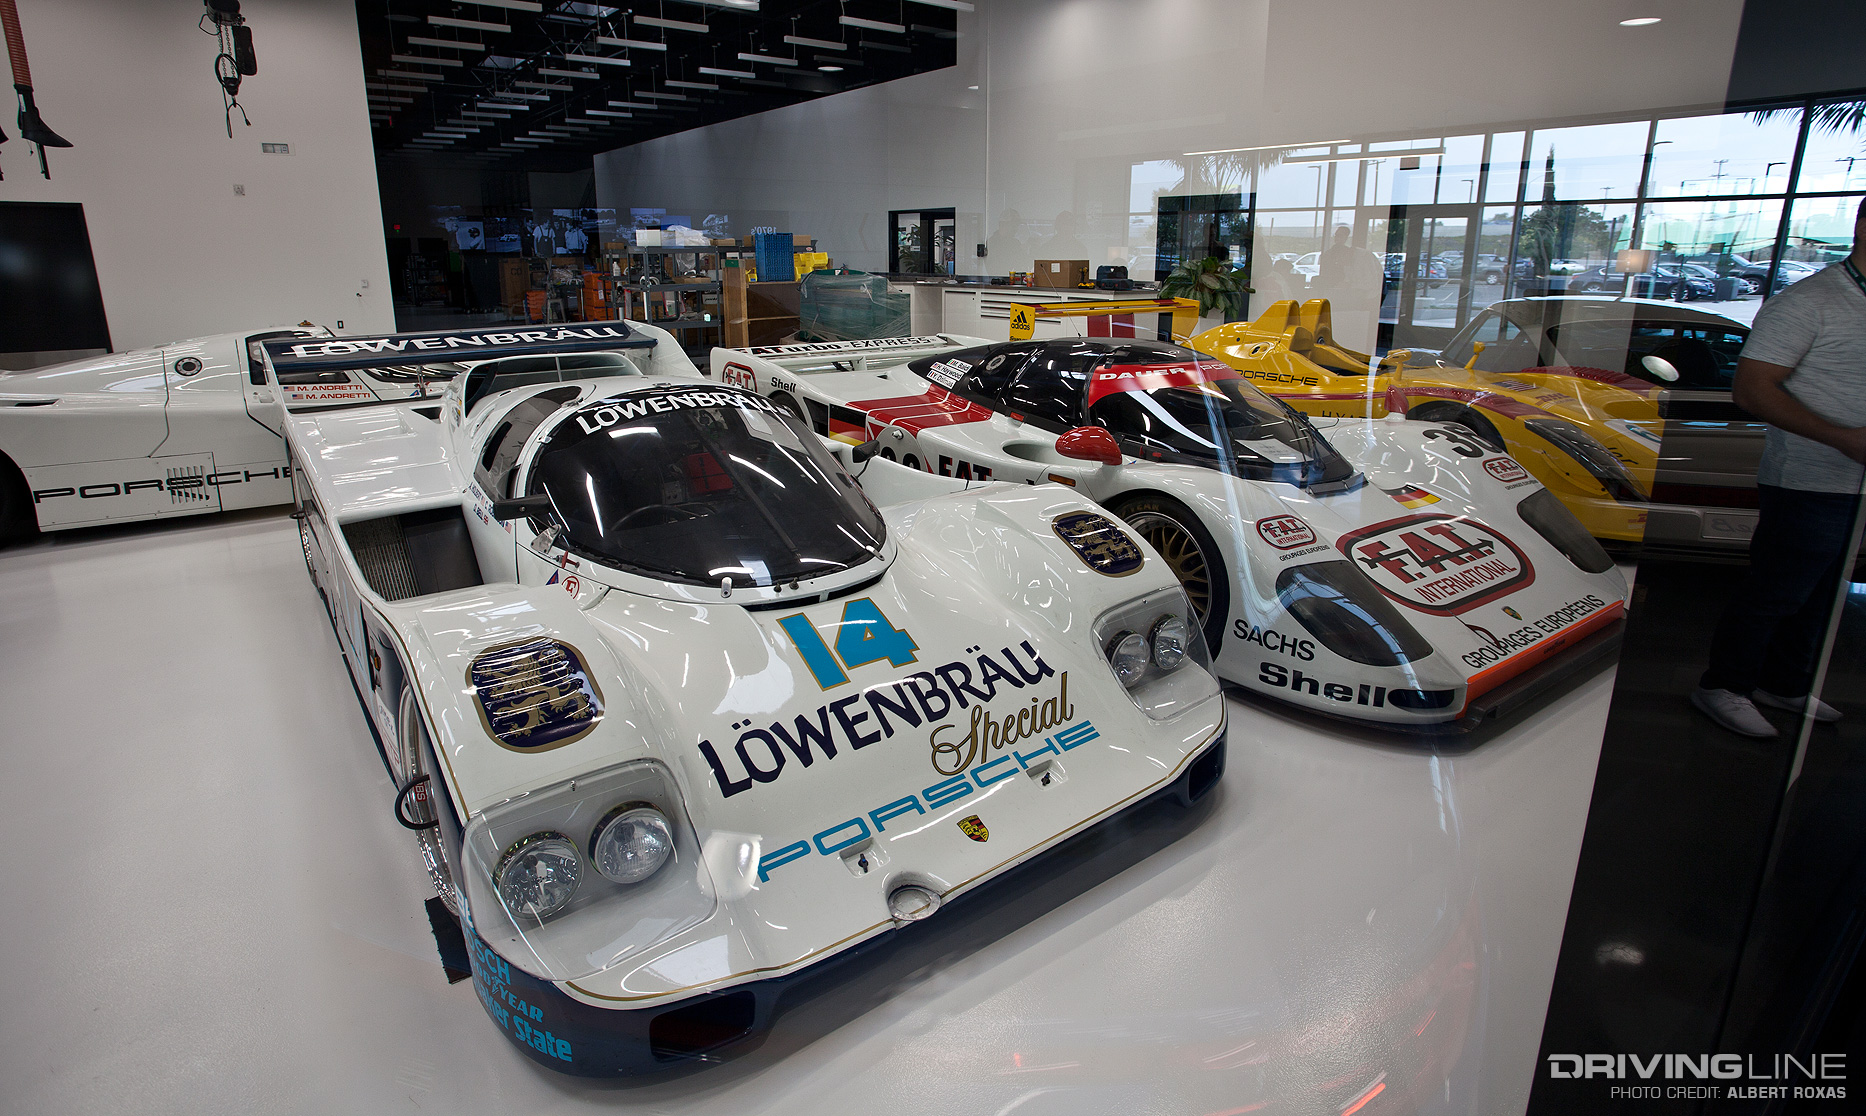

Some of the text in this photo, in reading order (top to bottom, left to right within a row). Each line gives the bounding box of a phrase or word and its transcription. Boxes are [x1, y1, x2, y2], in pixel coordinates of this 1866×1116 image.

[1011, 322, 1030, 330] adidas
[771, 377, 797, 393] Shell
[1100, 367, 1186, 381] DAUER
[1414, 558, 1517, 603] INTERNATIONAL
[776, 597, 920, 691] 14
[1233, 618, 1316, 662] SACHS
[1461, 626, 1543, 669] GROUPAGES
[1533, 594, 1606, 633] EUROPÉENS
[1258, 661, 1387, 708] Shell
[698, 640, 1056, 798] LÖWENBRÄU
[930, 670, 1074, 776] Special
[757, 720, 1101, 883] PORSCHE
[461, 918, 511, 985] OSCH
[513, 1015, 573, 1063] State
